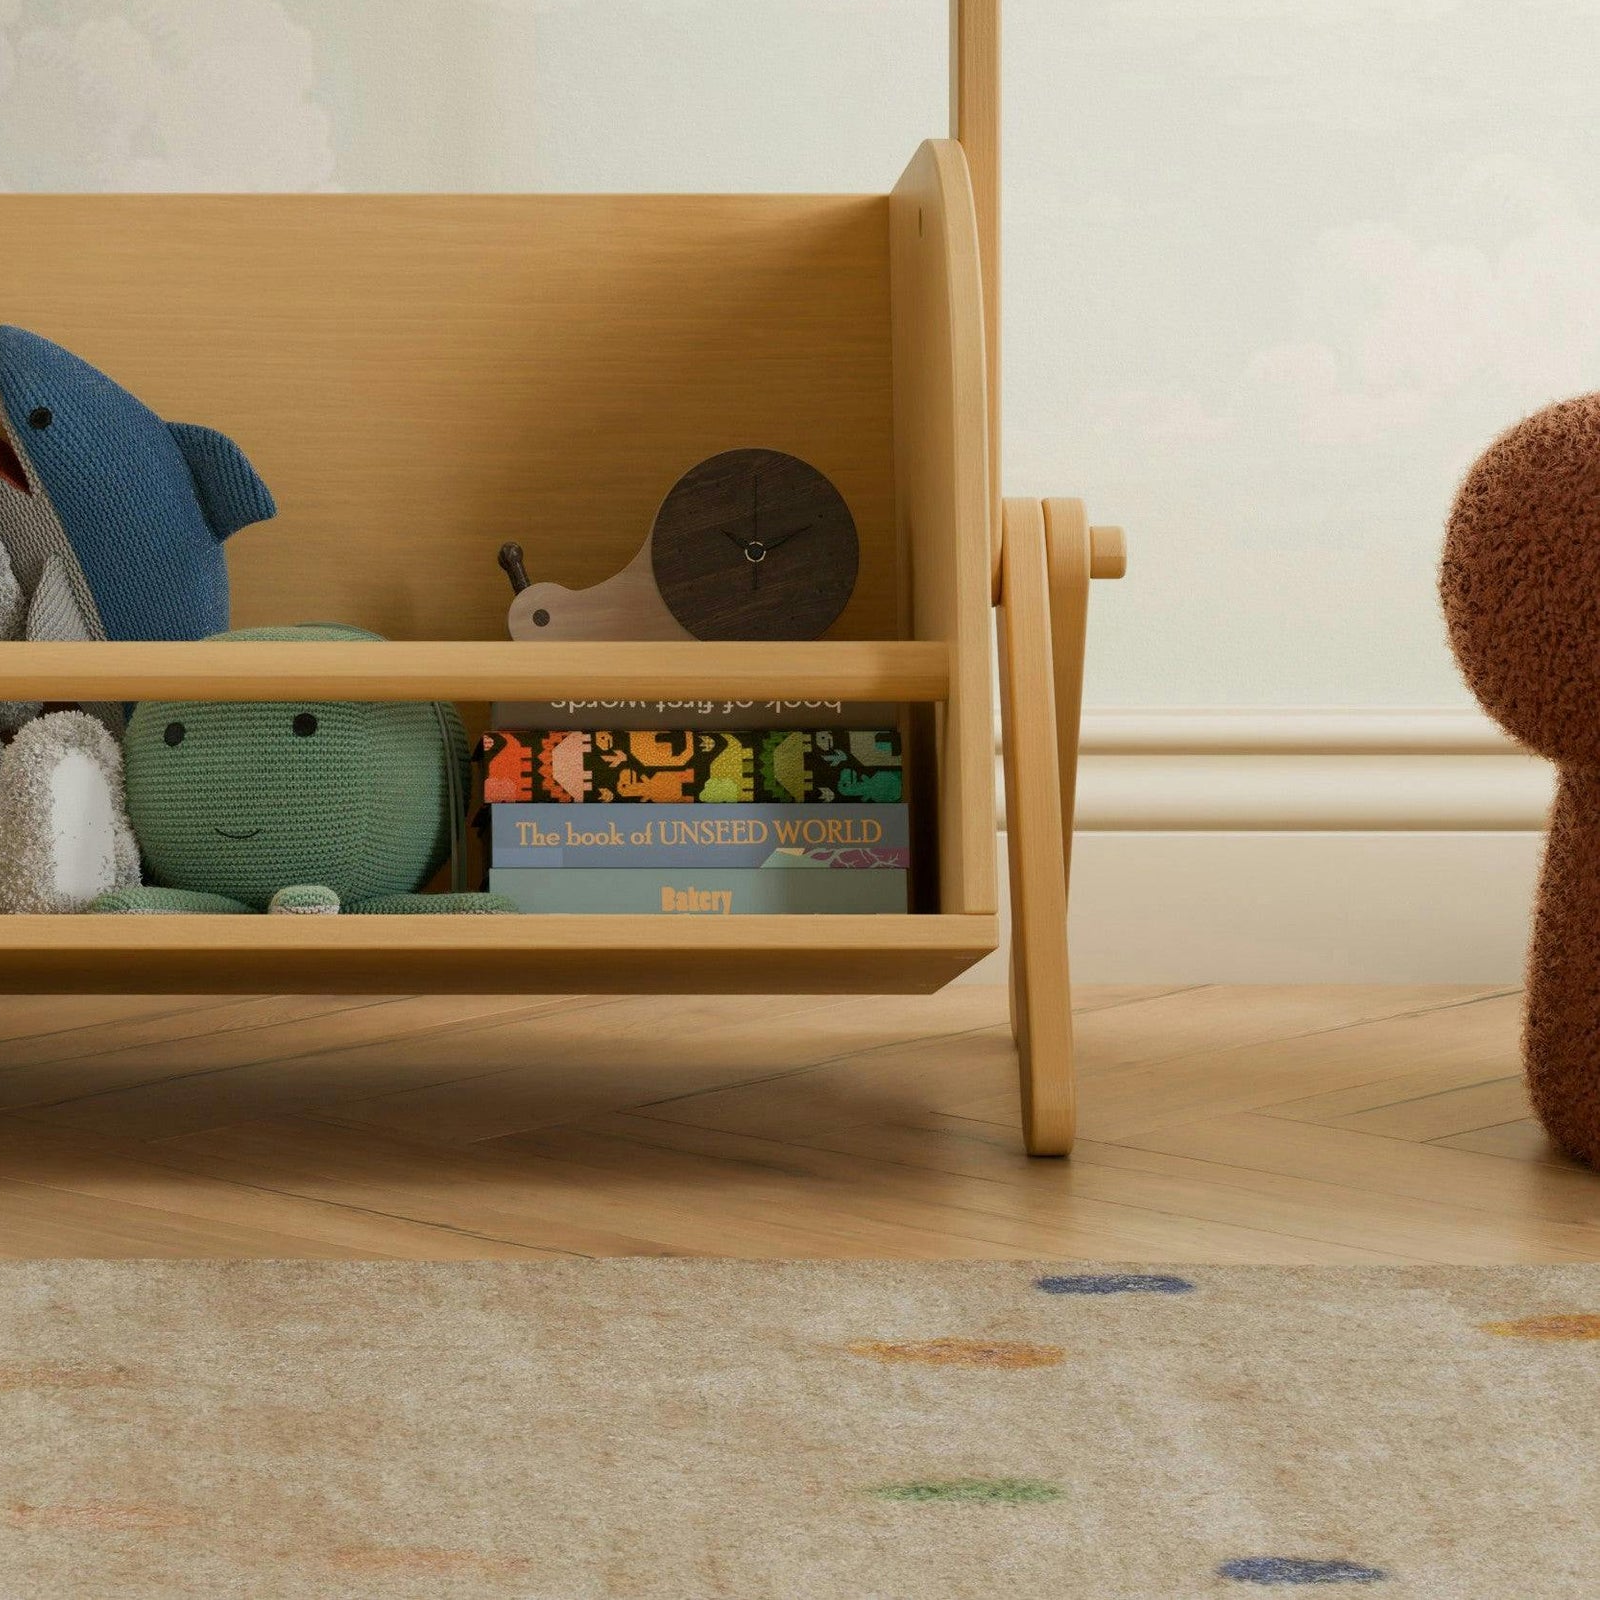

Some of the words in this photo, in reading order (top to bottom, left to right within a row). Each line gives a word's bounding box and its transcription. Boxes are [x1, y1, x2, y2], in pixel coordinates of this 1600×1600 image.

[516, 821, 560, 847] The
[565, 821, 627, 846] book
[630, 821, 655, 846] of
[658, 820, 769, 846] UNSEED
[773, 819, 884, 845] WORLD
[660, 885, 733, 914] Bakery
